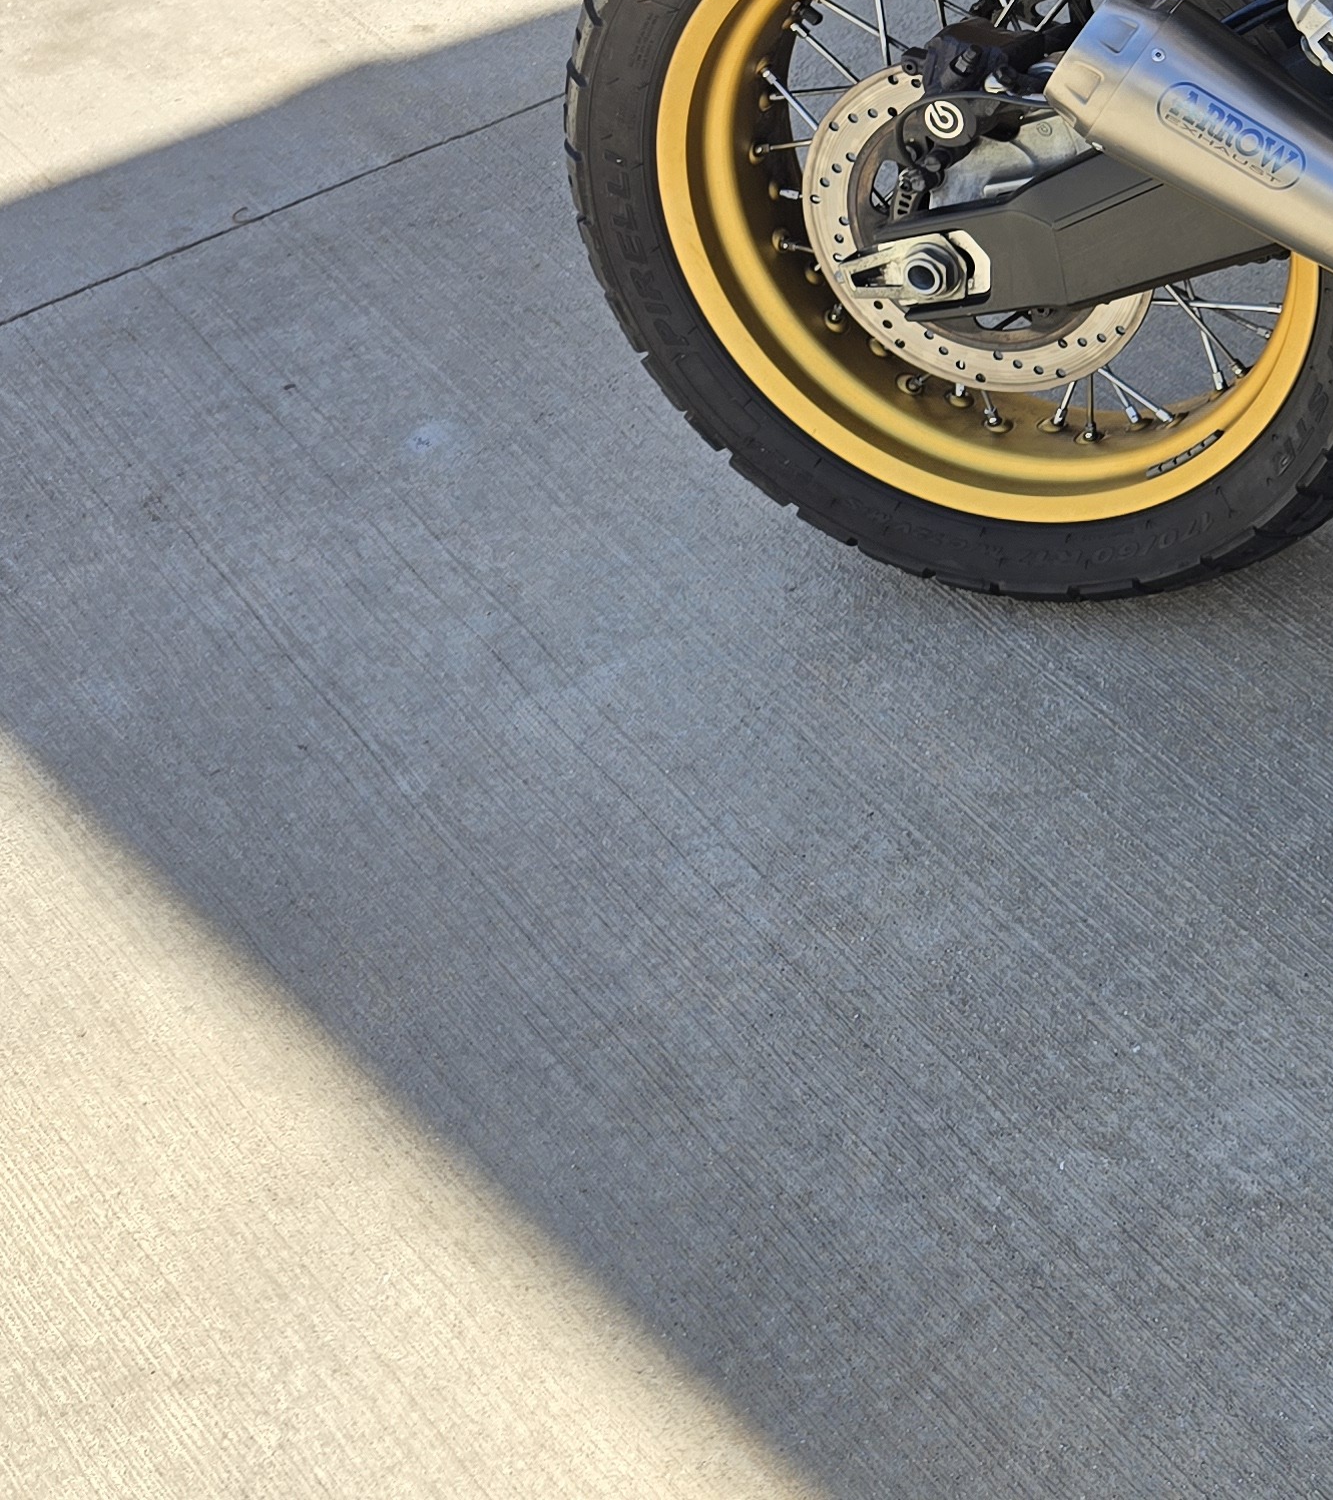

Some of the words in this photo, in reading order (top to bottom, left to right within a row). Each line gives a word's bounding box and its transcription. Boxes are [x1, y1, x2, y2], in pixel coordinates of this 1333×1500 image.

[1164, 113, 1283, 183] EXHAUST
[1168, 91, 1300, 175] ARROW
[602, 146, 696, 357] PIRELLI
